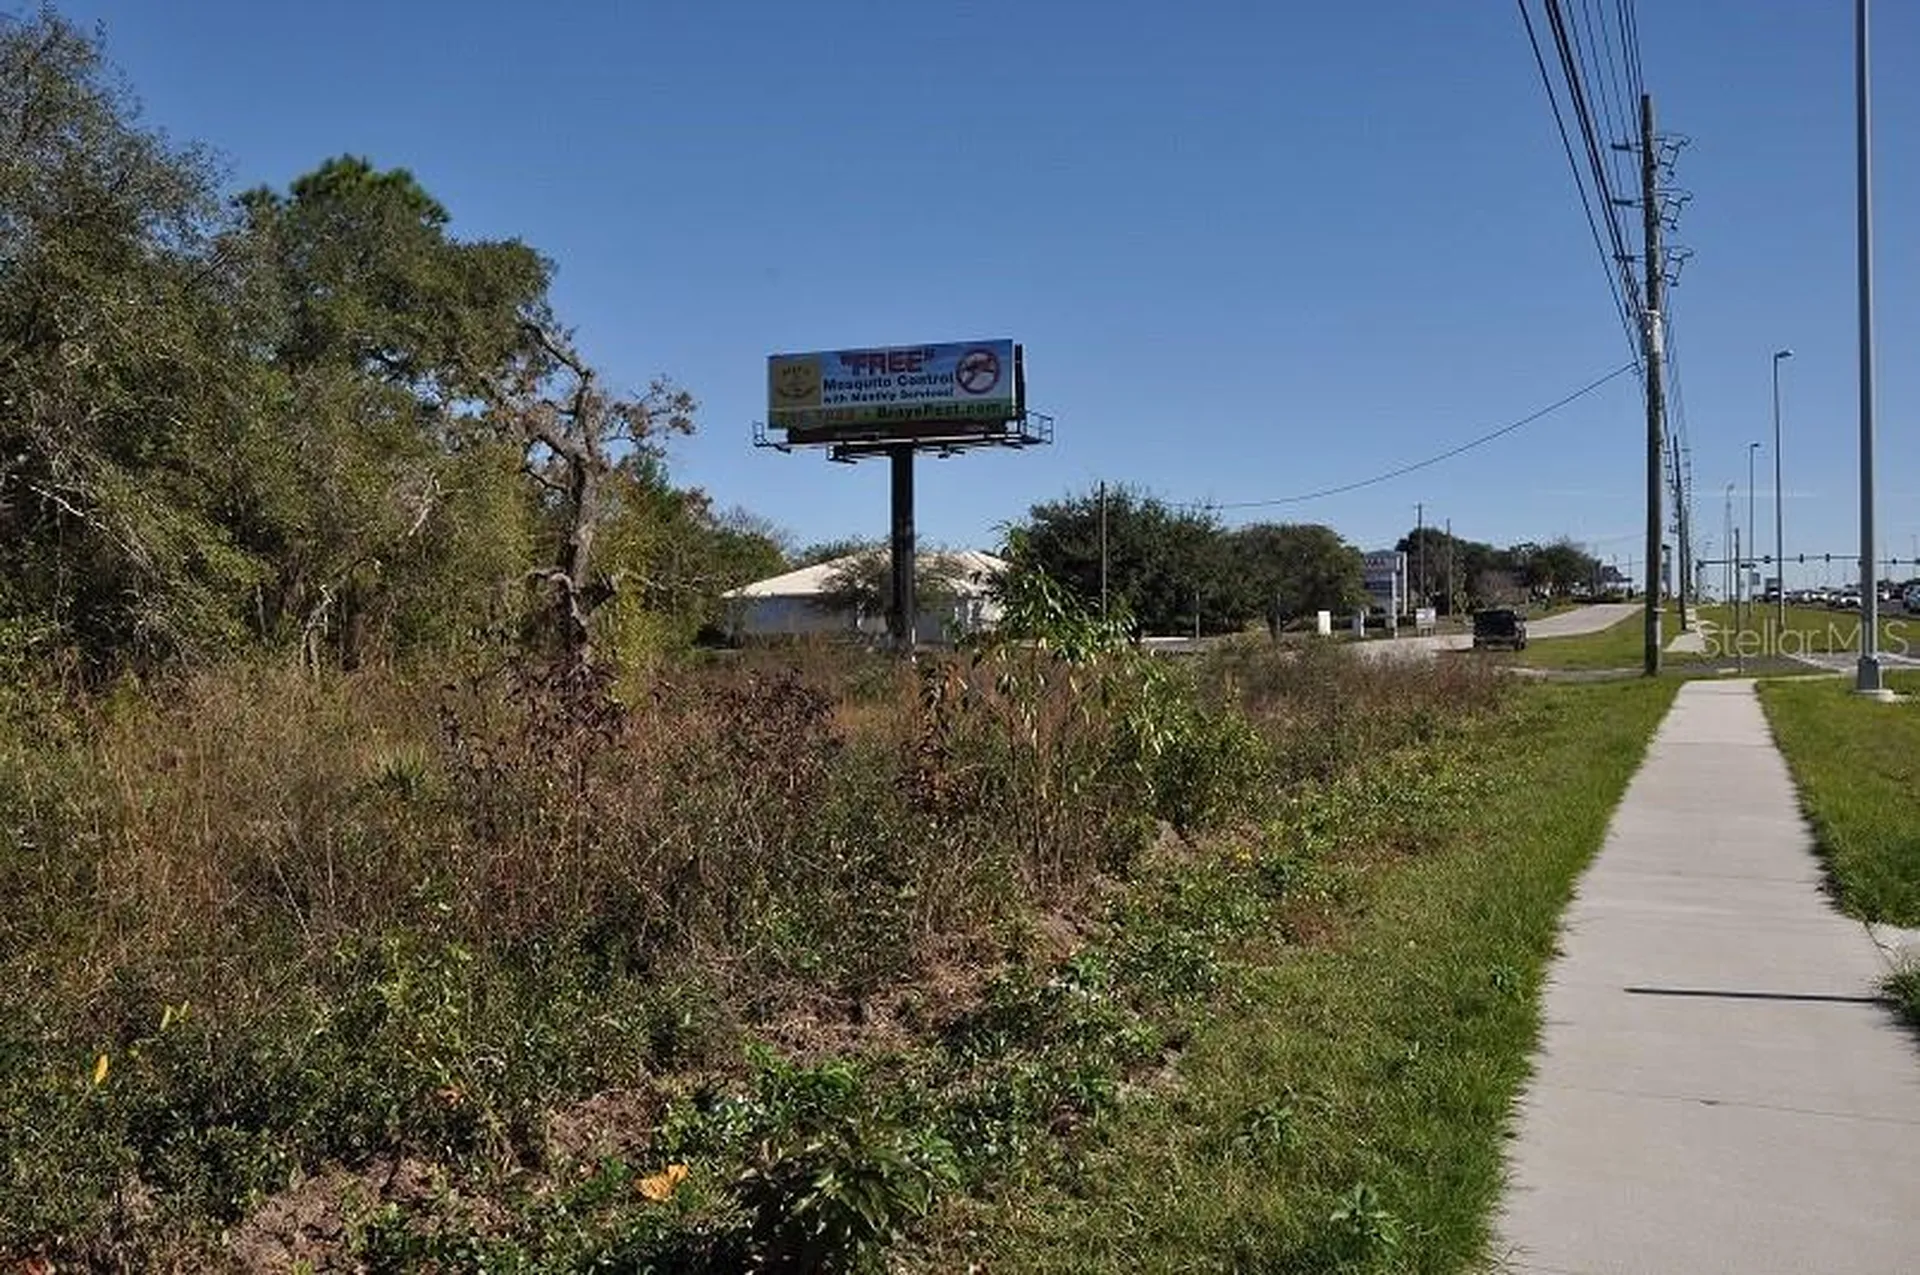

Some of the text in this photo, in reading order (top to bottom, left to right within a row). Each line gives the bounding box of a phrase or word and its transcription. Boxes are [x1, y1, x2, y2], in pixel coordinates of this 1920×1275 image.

[823, 372, 954, 391] Mosquito Control
[823, 392, 848, 404] with
